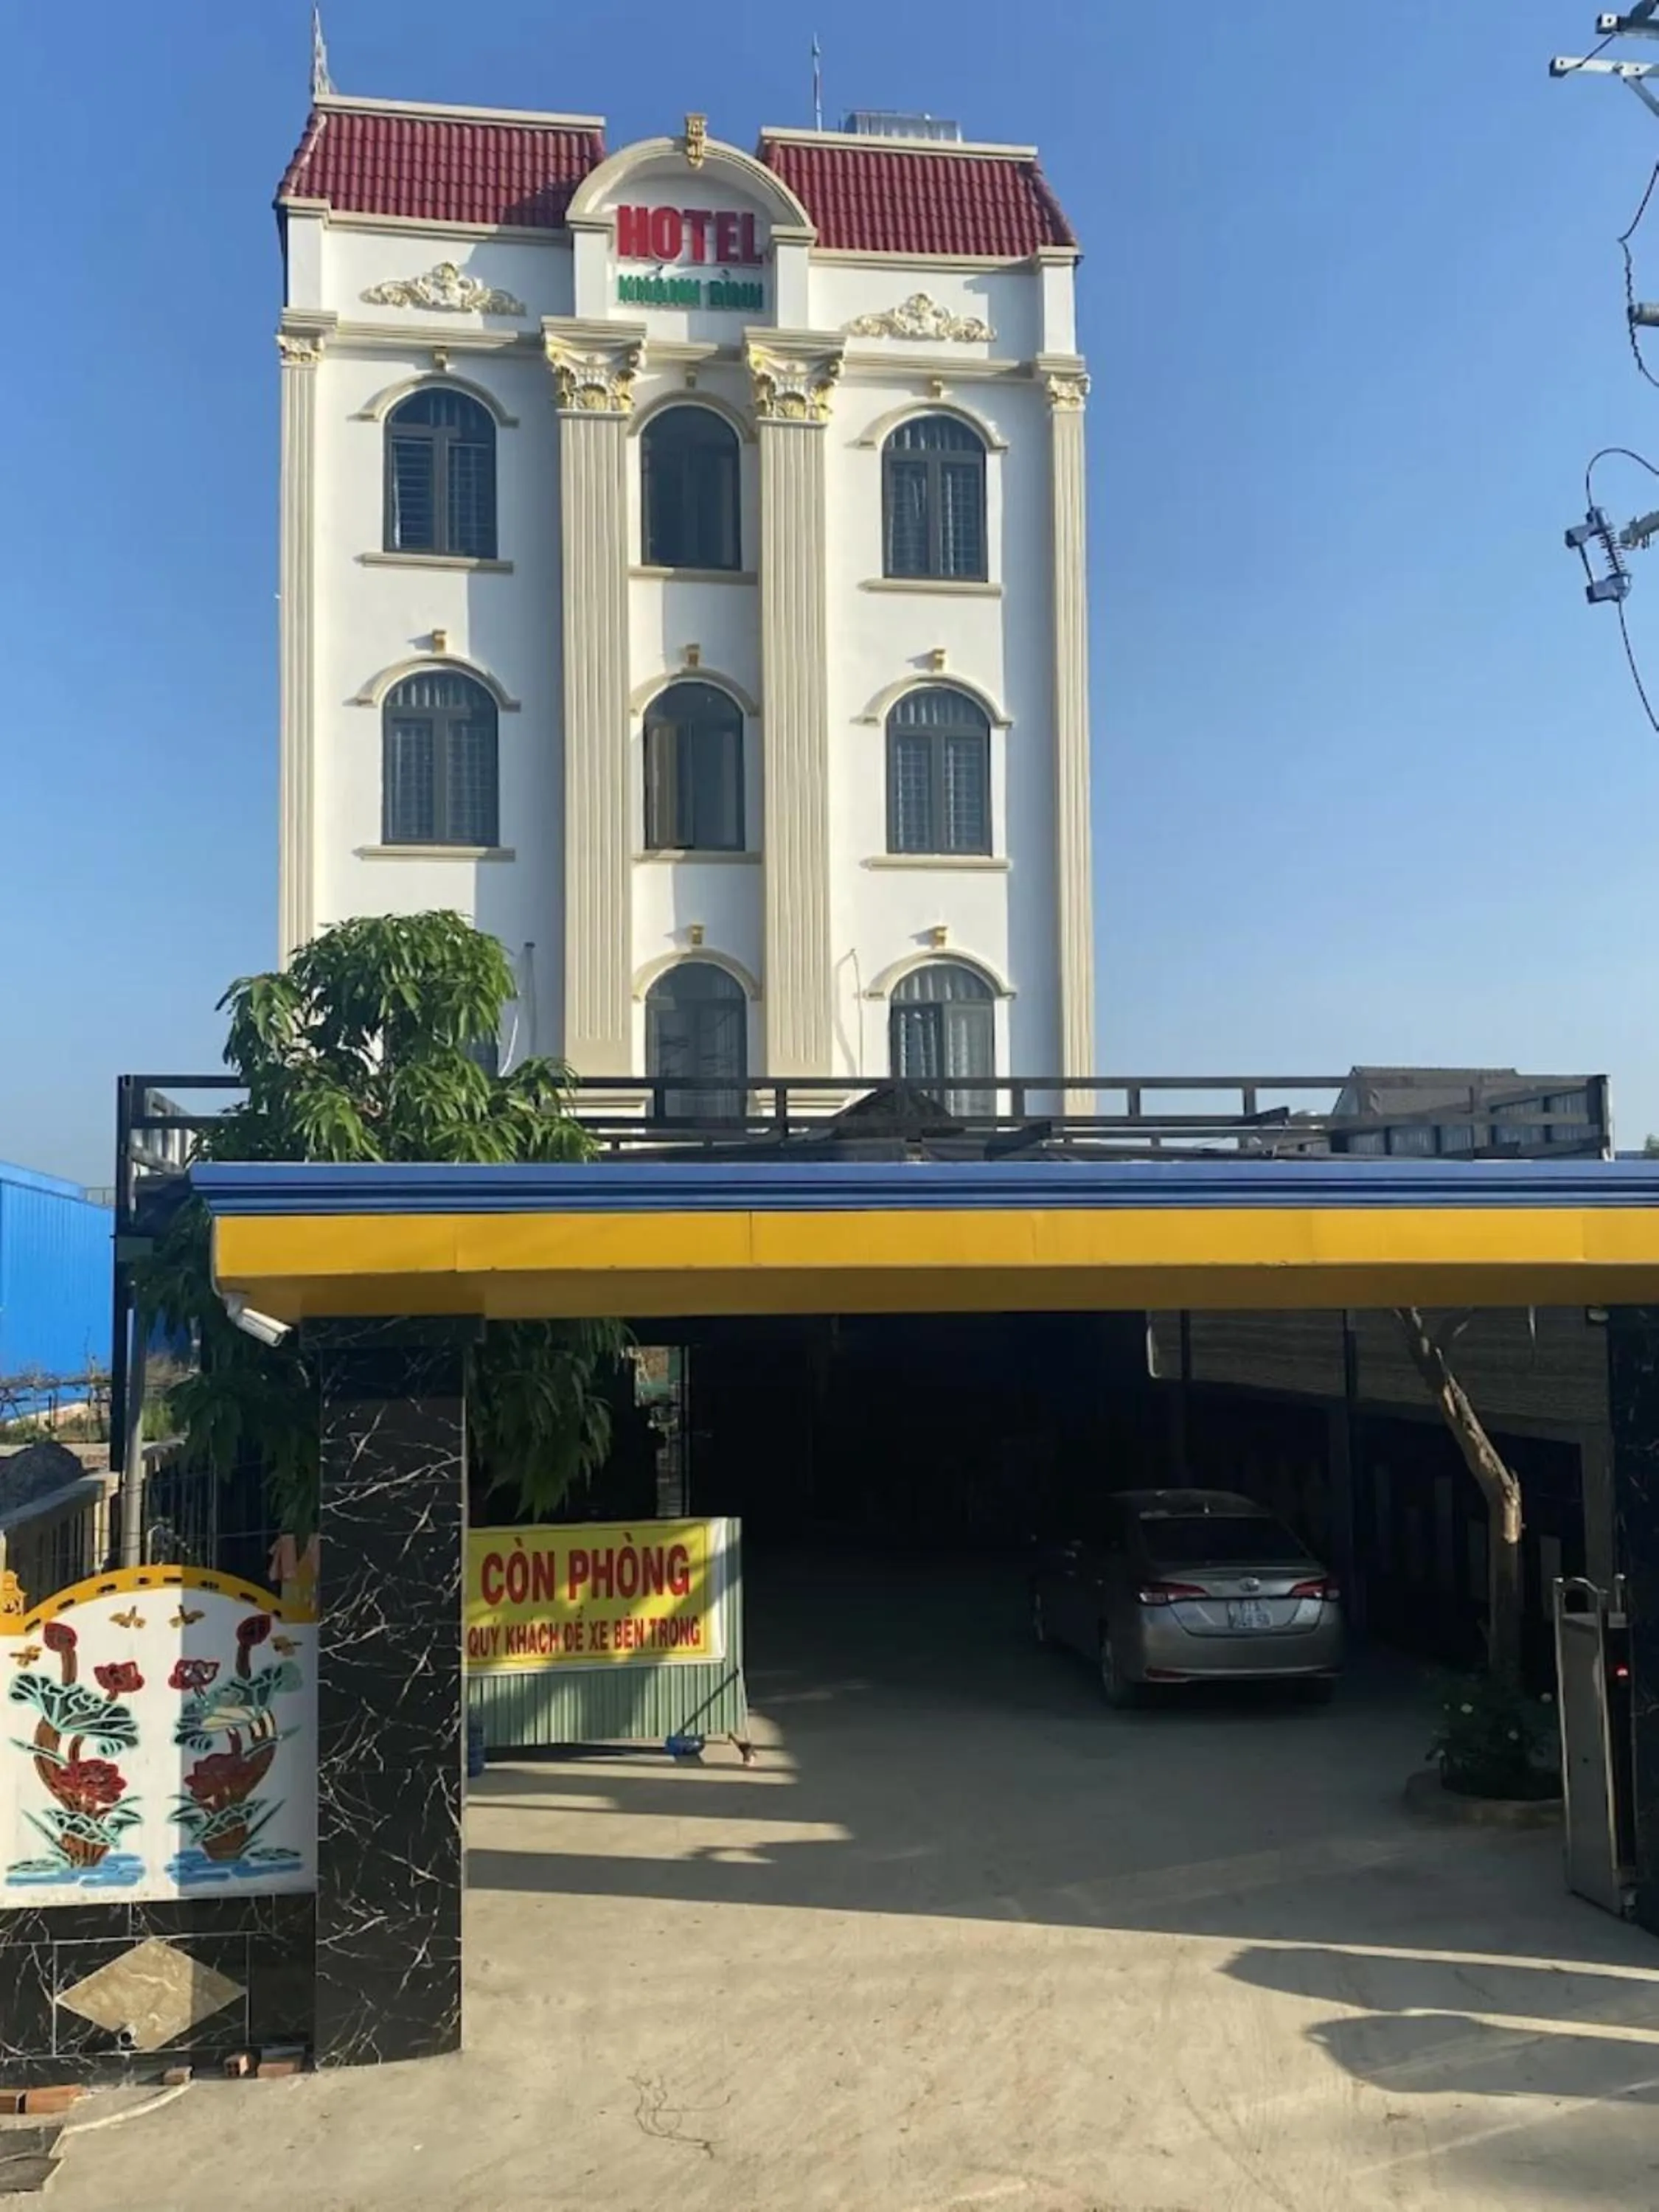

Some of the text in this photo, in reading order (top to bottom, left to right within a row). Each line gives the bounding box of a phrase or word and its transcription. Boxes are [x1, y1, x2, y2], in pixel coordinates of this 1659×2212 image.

[617, 205, 764, 265] HOTEL
[481, 1532, 690, 1605] CÒN PHÒNG
[467, 1616, 501, 1658] QUÝ
[506, 1616, 560, 1655] KHÁCH
[588, 1620, 608, 1651] XE
[614, 1612, 644, 1649] BÊN
[649, 1615, 700, 1648] TRONG
